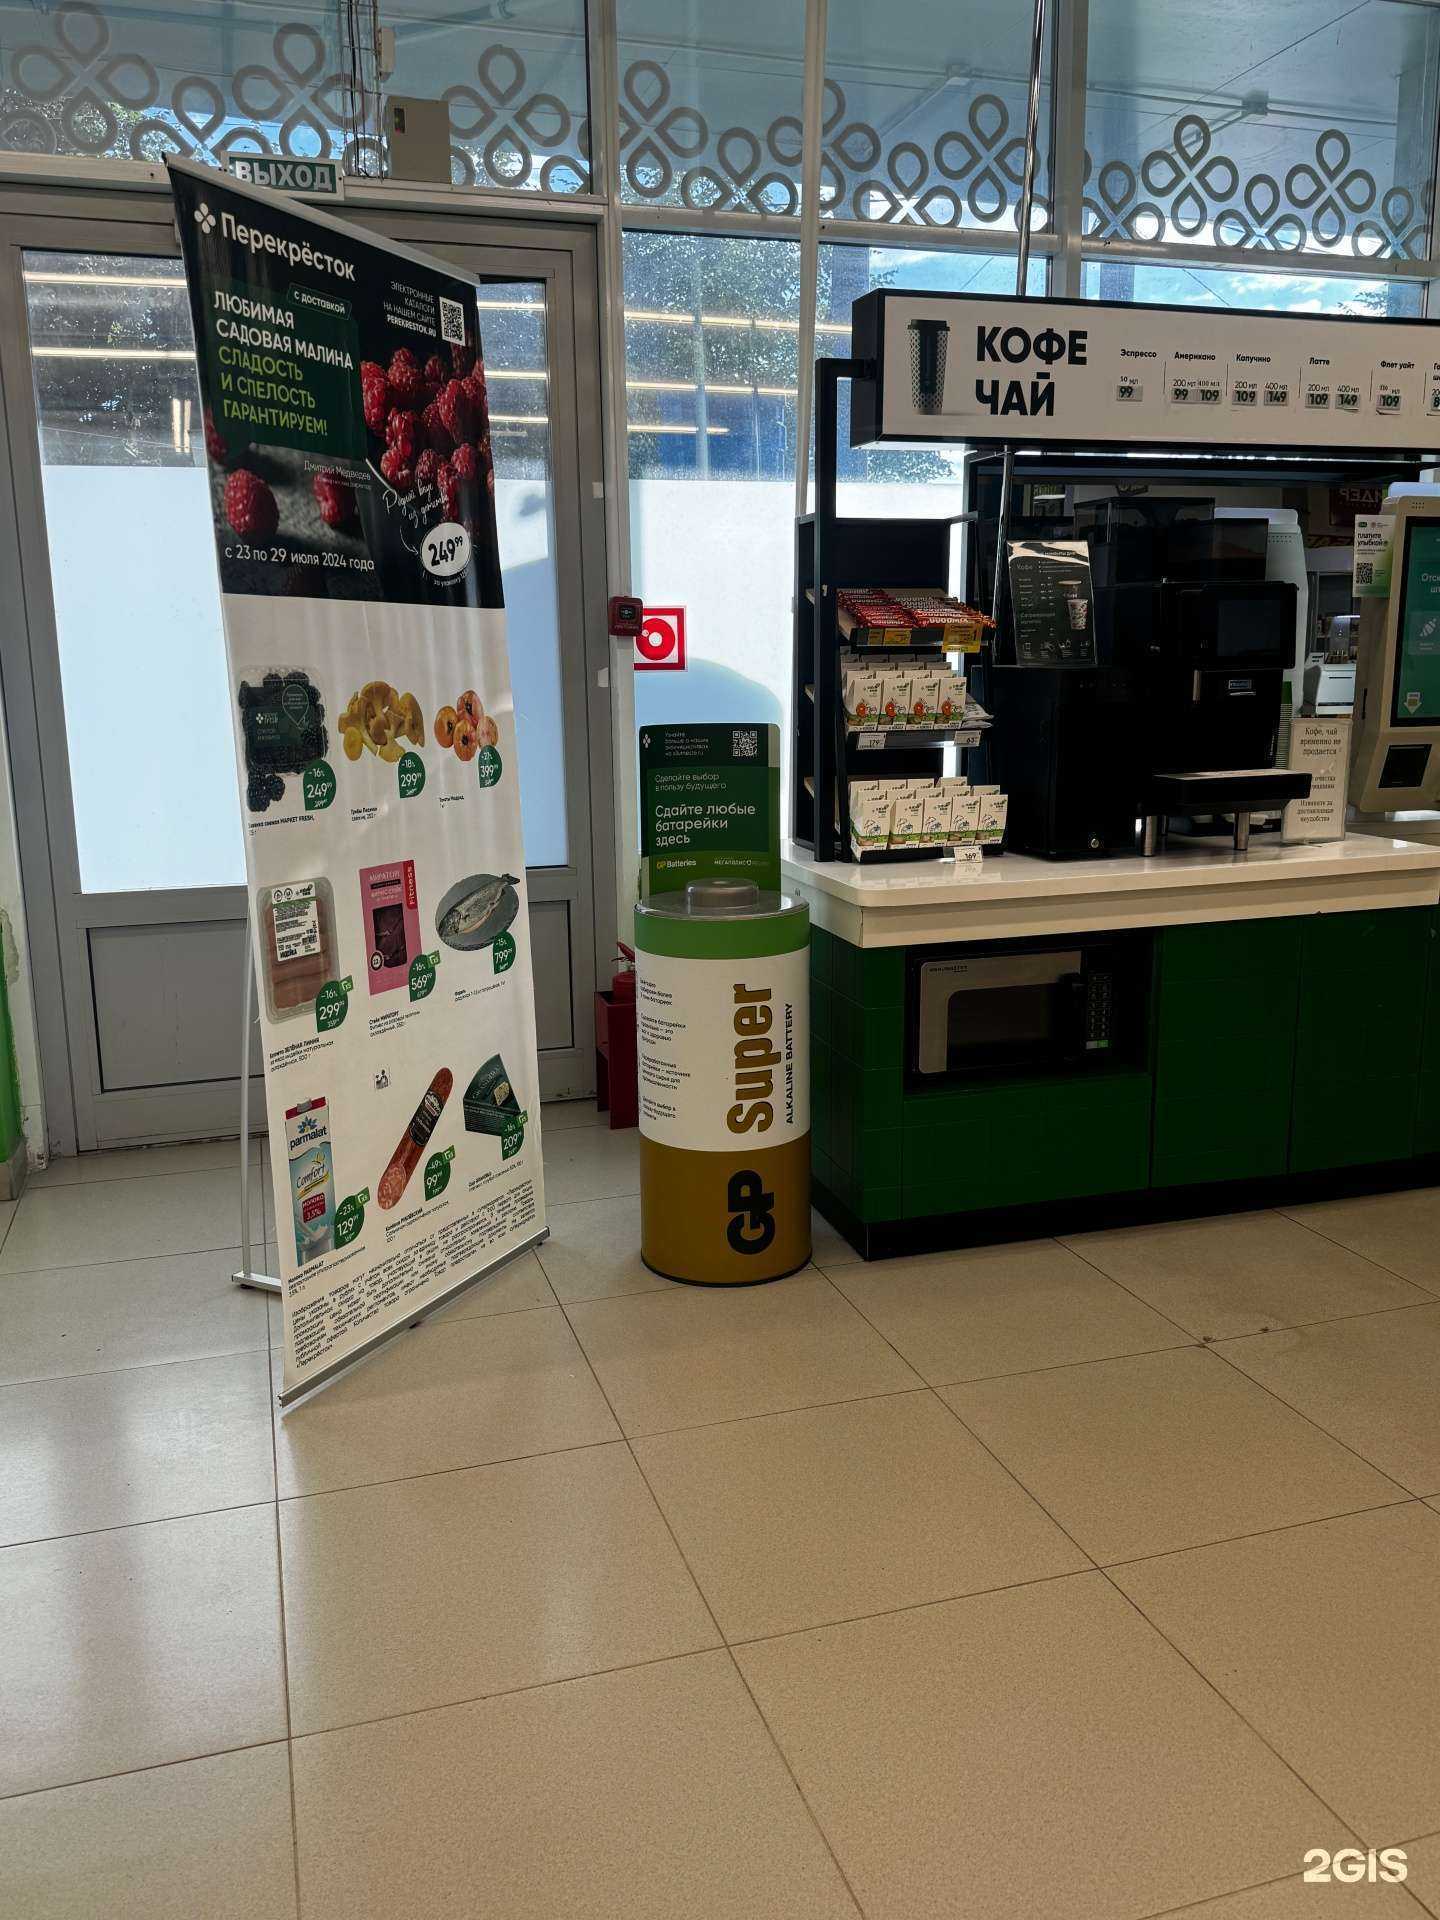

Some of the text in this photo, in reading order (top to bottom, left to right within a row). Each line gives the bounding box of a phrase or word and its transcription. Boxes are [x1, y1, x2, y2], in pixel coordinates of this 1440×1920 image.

[234, 160, 333, 191] ВЫХОД
[221, 212, 355, 281] Перекрёсток
[214, 291, 294, 329] ЛЮБИМАЯ
[301, 292, 345, 314] доставкой
[216, 319, 354, 370] САДОВАЯ МАЛИНА
[976, 326, 1088, 365] КОФЕ
[1120, 349, 1157, 358] Эспрессо
[218, 346, 304, 381] СЛАДОСТЬ
[1174, 352, 1216, 361] Американо
[1309, 357, 1330, 366] Латте
[220, 372, 316, 409] И СПЕЛОСТЬ
[976, 372, 1055, 416] ЧАЙ
[1119, 386, 1133, 398] 99
[1173, 389, 1219, 400] 99 109
[1235, 391, 1287, 402] 109 149
[1309, 394, 1329, 405] 109
[1382, 395, 1400, 407] 109
[223, 399, 328, 436] ГАРАНТИРУЕМ!
[225, 547, 232, 558] с
[236, 545, 251, 559] 23
[253, 550, 267, 561] по
[270, 548, 287, 562] 29
[322, 552, 347, 567] 2024
[349, 559, 375, 572] года
[685, 781, 727, 791] будущего
[692, 773, 720, 782] выбор
[655, 802, 756, 818] Сдайте любые
[655, 817, 729, 832] батарейки
[655, 833, 691, 847] здесь
[666, 859, 697, 868] Batteries
[726, 983, 781, 1135] Super
[785, 1003, 794, 1125] ALKALINE BATTERY
[289, 1126, 328, 1151] parmalat
[296, 1164, 325, 1189] Comfort
[726, 1169, 776, 1255] GP
